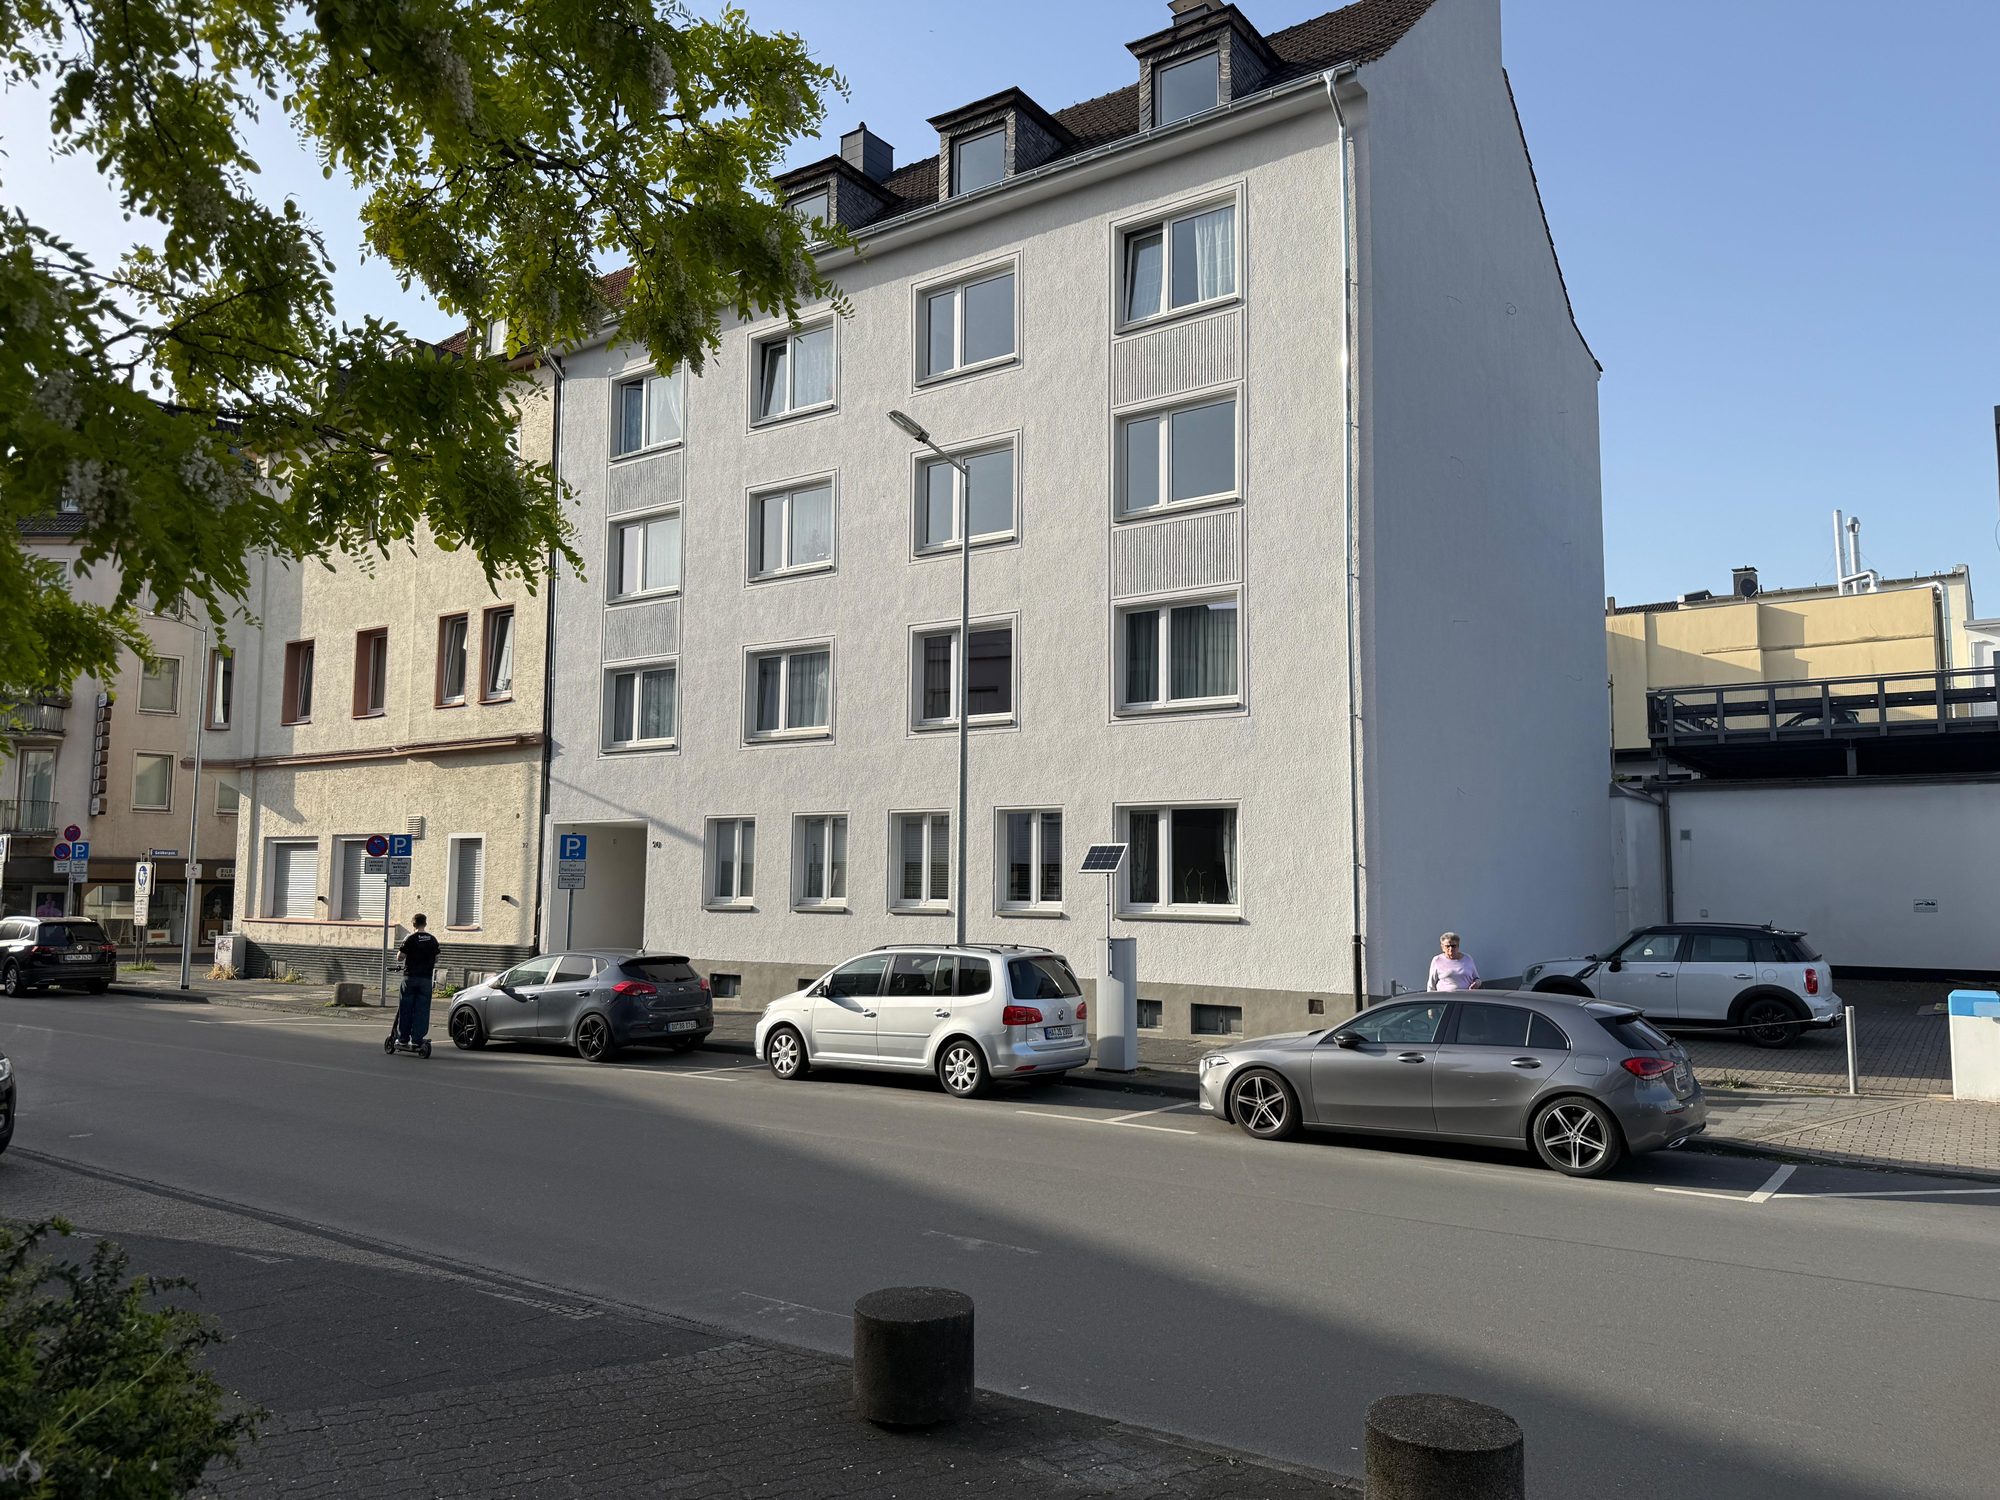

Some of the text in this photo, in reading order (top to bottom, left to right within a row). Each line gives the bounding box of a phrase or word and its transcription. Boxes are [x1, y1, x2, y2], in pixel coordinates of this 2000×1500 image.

[75, 844, 85, 858] P
[394, 837, 407, 854] P
[566, 837, 581, 857] P
